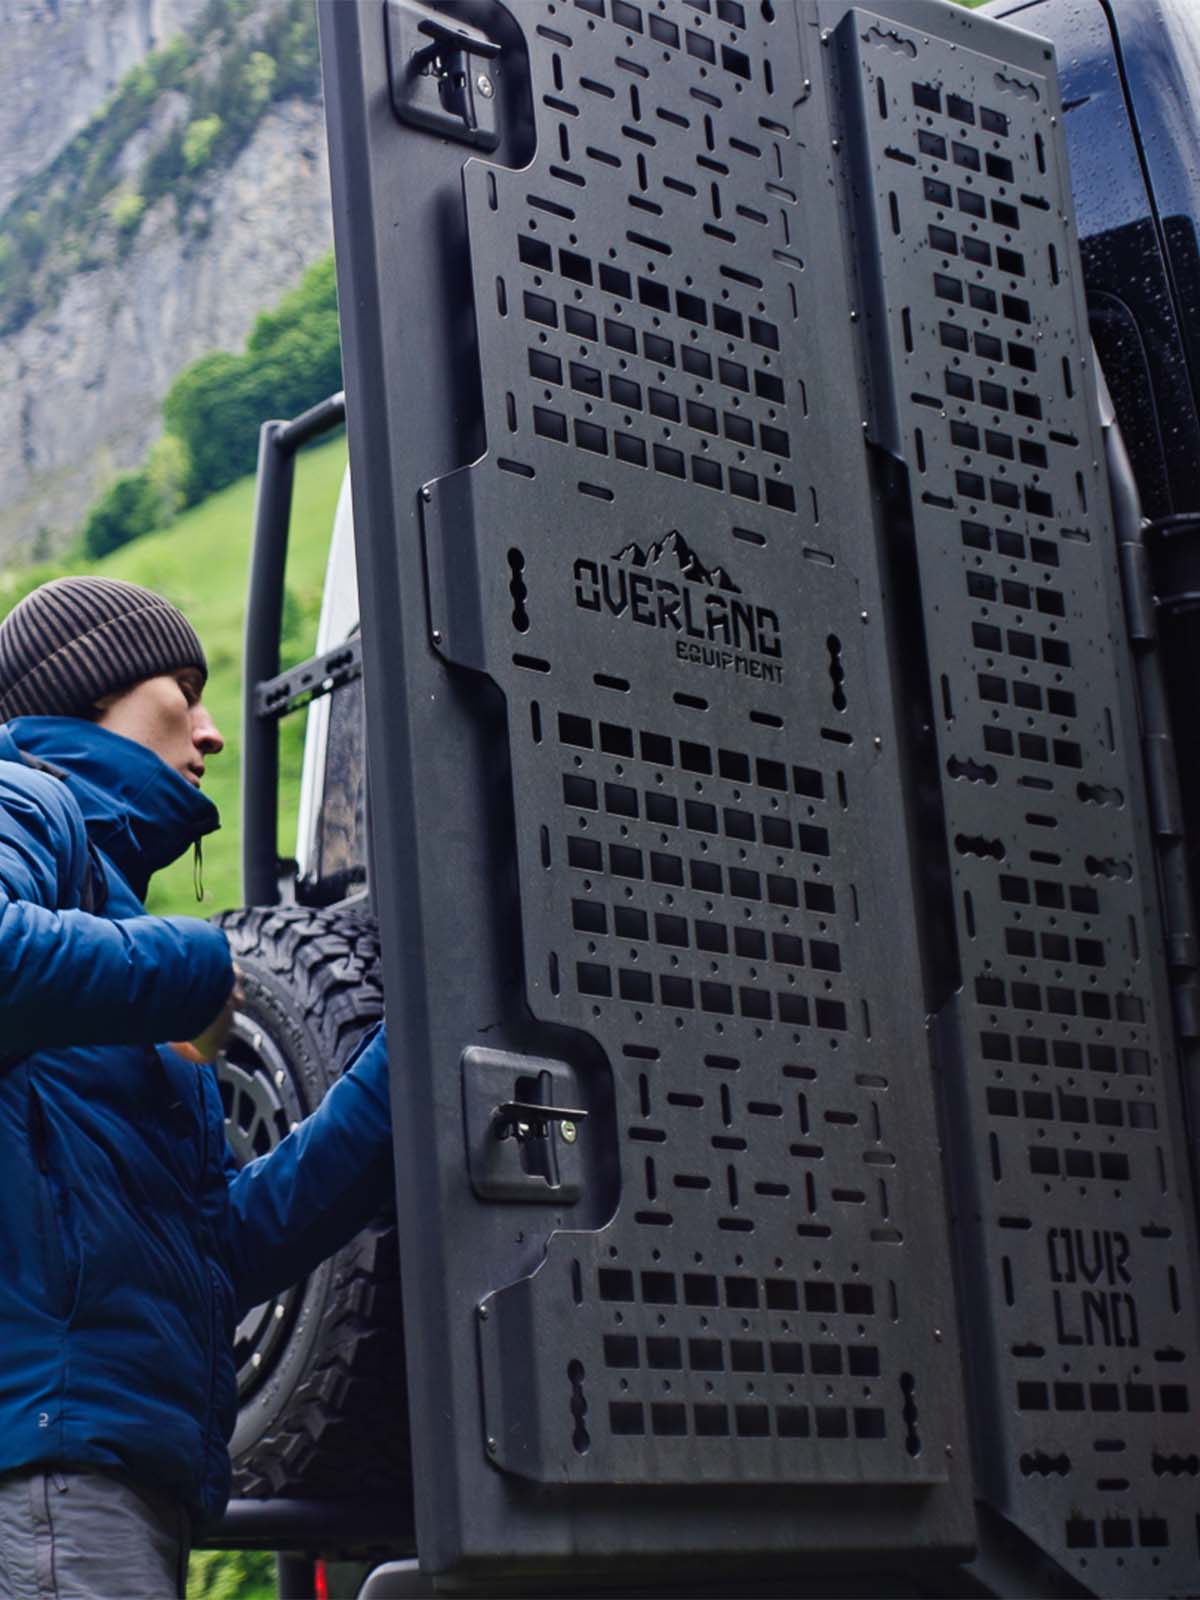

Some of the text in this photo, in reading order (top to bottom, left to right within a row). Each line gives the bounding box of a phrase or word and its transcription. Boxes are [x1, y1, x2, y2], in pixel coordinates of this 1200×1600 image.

[573, 558, 783, 658] OVERLAND
[676, 641, 783, 684] EQUIPMENT
[1047, 1228, 1132, 1285] OVR
[1052, 1289, 1139, 1347] LND
